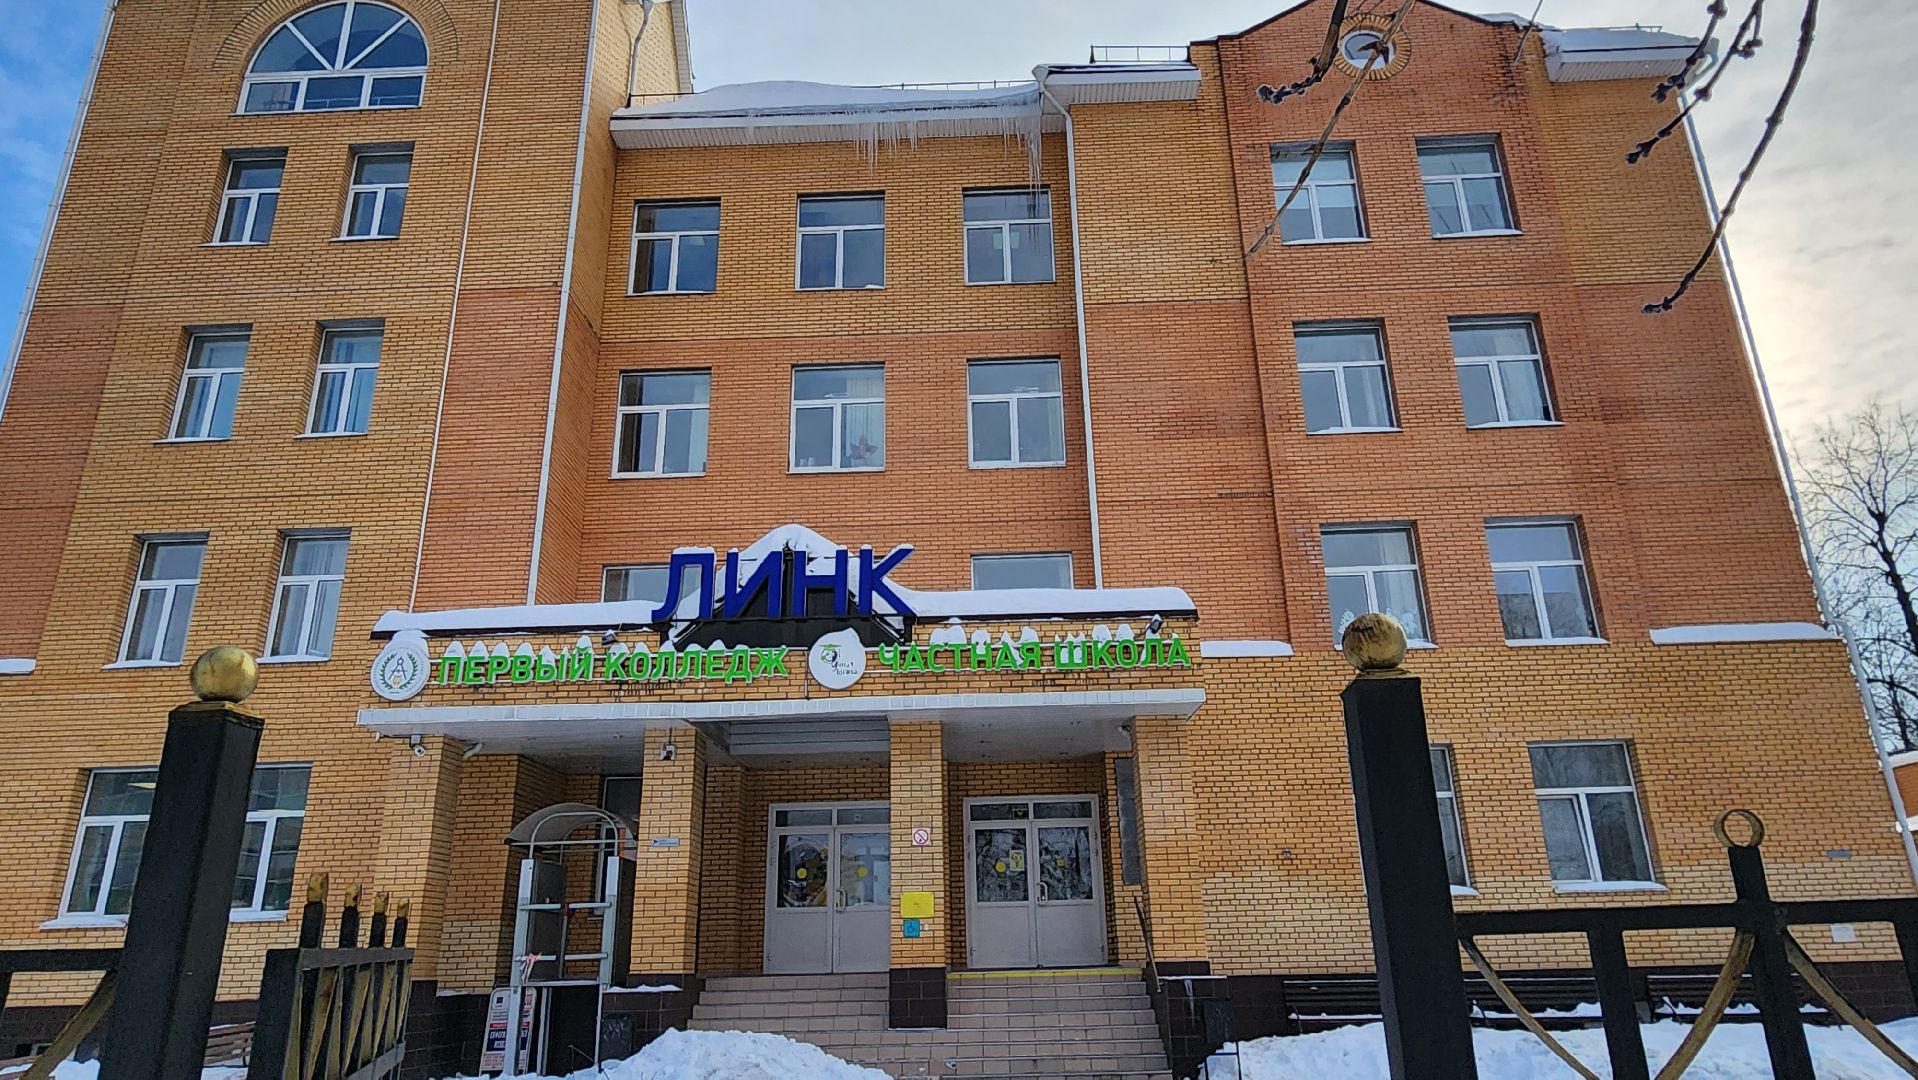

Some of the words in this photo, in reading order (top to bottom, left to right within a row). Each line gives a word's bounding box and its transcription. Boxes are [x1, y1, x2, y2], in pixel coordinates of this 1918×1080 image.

[651, 547, 917, 622] ЛИНК
[438, 646, 595, 685] ПЕРВЫЙ
[604, 645, 790, 685] КОЛЛЕДЖ
[878, 641, 1042, 673] ЧАСТНАЯ
[1054, 637, 1192, 670] ШКОЛА
